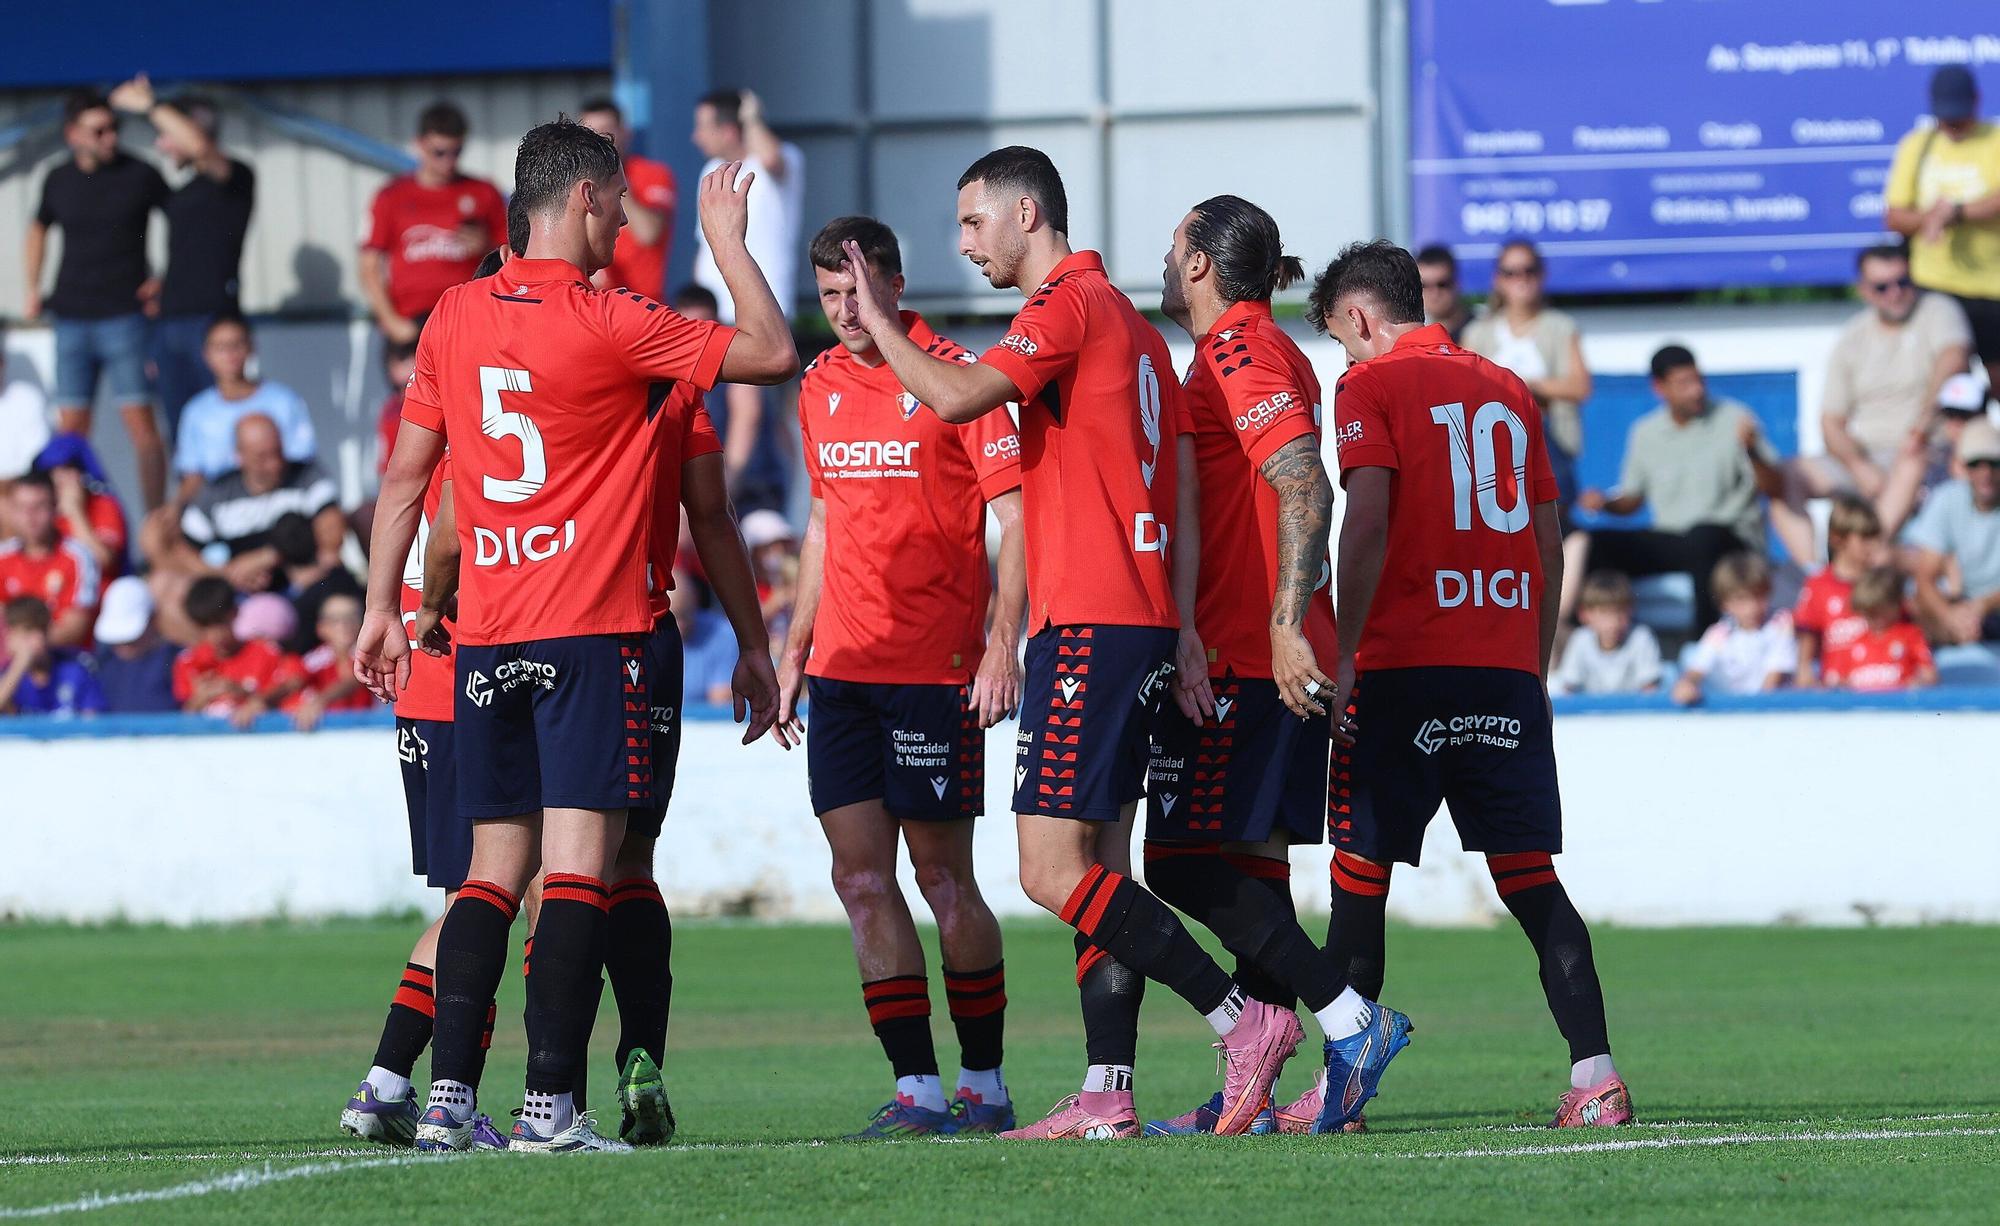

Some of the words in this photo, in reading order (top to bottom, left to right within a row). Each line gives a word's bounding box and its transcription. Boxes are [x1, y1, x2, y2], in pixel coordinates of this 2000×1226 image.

[1247, 391, 1292, 422] CELER
[1138, 354, 1161, 490] 9
[480, 366, 547, 503] 5
[997, 434, 1020, 452] CEL
[838, 469, 883, 479] Climatización
[884, 468, 919, 479] eficiente
[1430, 401, 1530, 534] 10
[474, 519, 576, 567] DIGI
[1435, 569, 1530, 610] DIGI
[495, 657, 557, 680] CRYPTO
[892, 729, 925, 742] Clínica
[1449, 714, 1521, 736] CRYPTO
[893, 741, 950, 754] Universidad
[905, 754, 947, 767] Navarra
